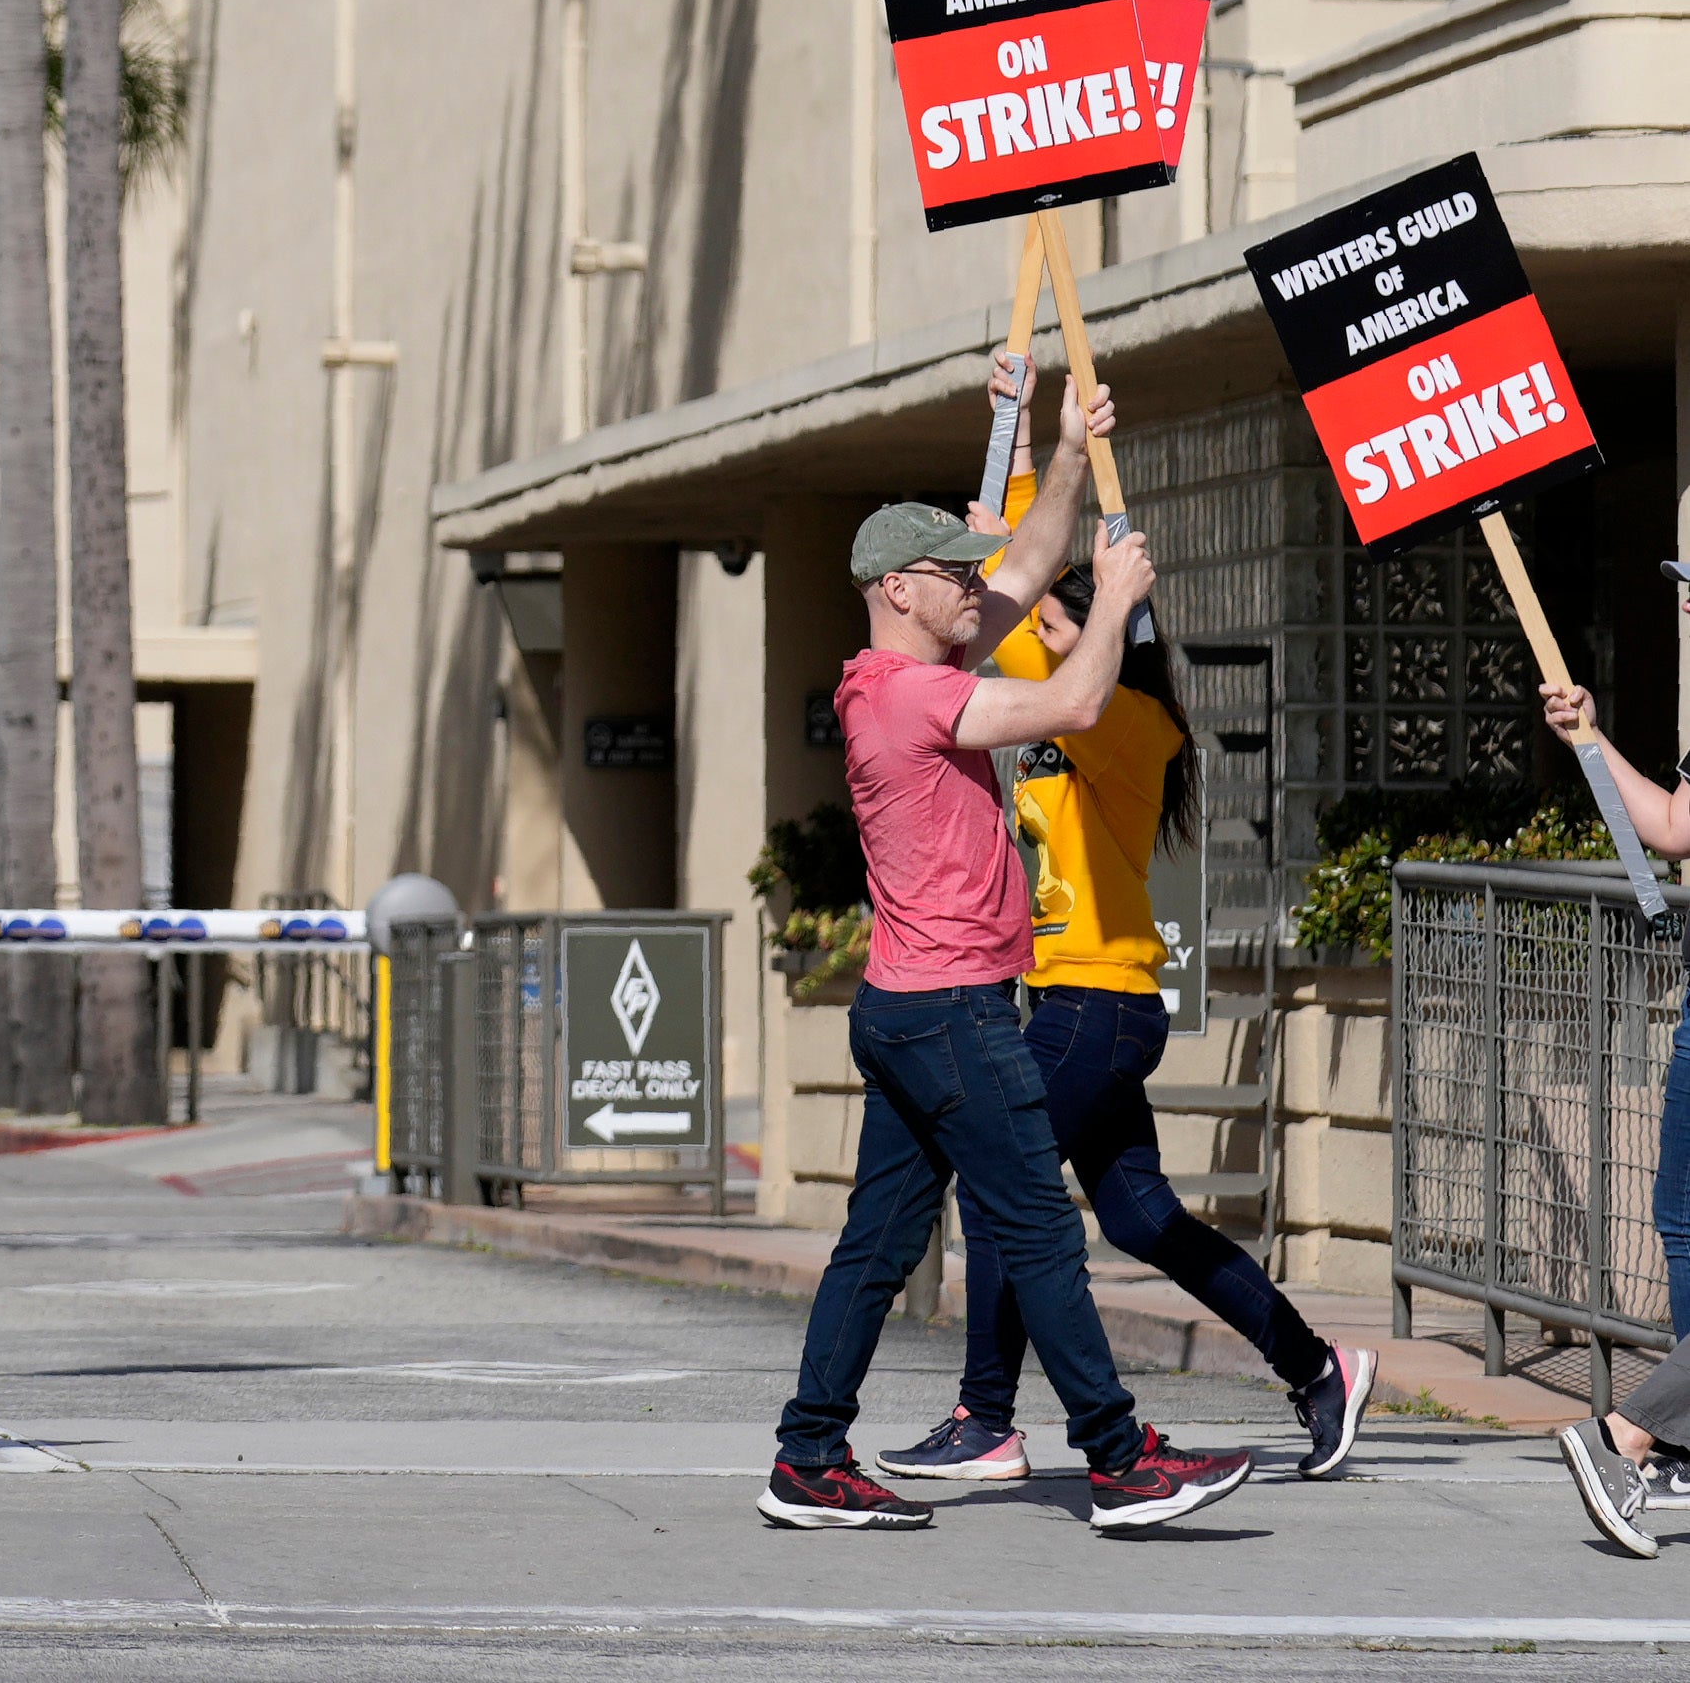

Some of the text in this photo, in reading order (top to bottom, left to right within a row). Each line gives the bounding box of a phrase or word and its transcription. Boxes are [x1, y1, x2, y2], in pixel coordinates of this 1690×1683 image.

[997, 34, 1048, 79] ON
[920, 65, 1142, 171] STRIKE!
[1271, 191, 1478, 302] WRITERS GUILD
[1375, 265, 1406, 297] OF
[1345, 279, 1470, 357] AMERICA
[1407, 353, 1462, 402] ON
[1344, 361, 1567, 505] STRIKE!
[571, 1079, 701, 1100] DECAL ONLY
[581, 1060, 692, 1080] FAST PASS
